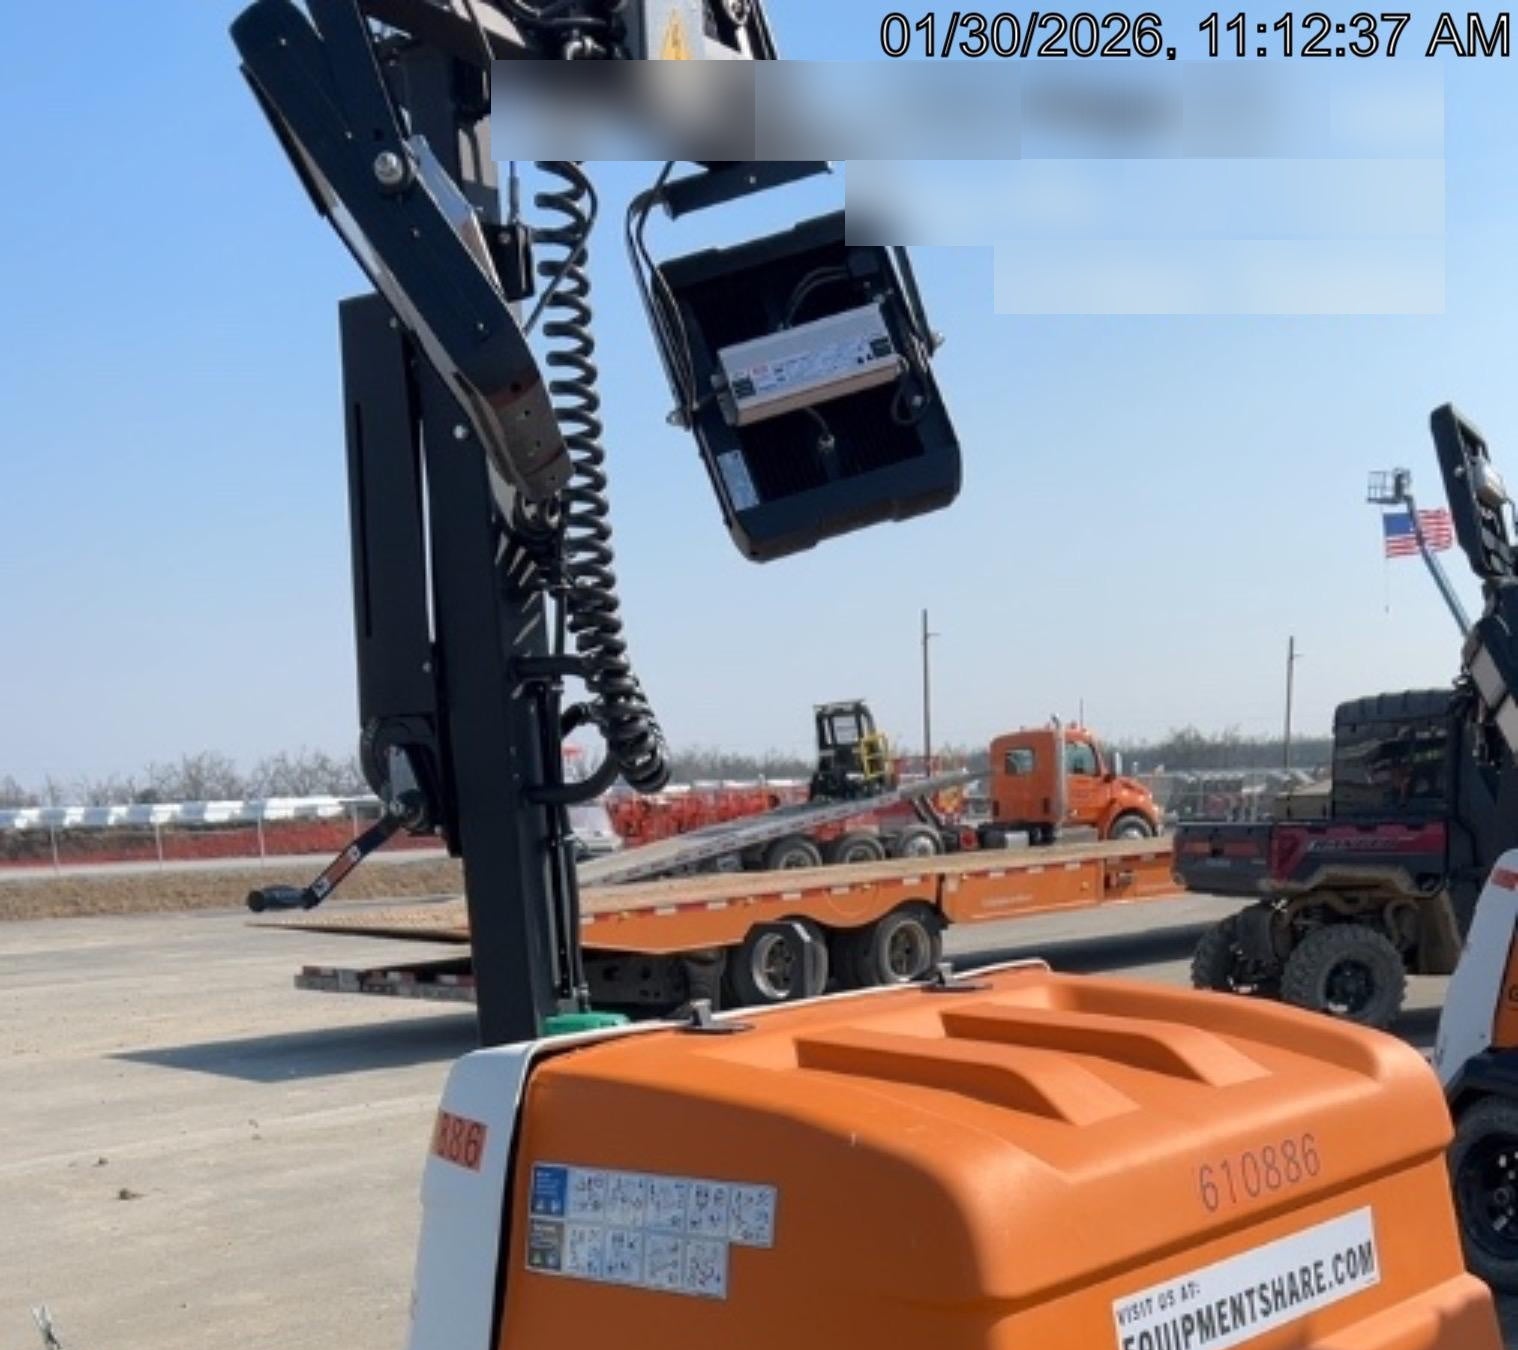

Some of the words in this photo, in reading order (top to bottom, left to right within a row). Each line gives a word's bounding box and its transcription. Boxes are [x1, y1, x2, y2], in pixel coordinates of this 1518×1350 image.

[1200, 1133, 1321, 1212] 610886
[1116, 1297, 1153, 1326] VISIT
[1158, 1289, 1175, 1311] US
